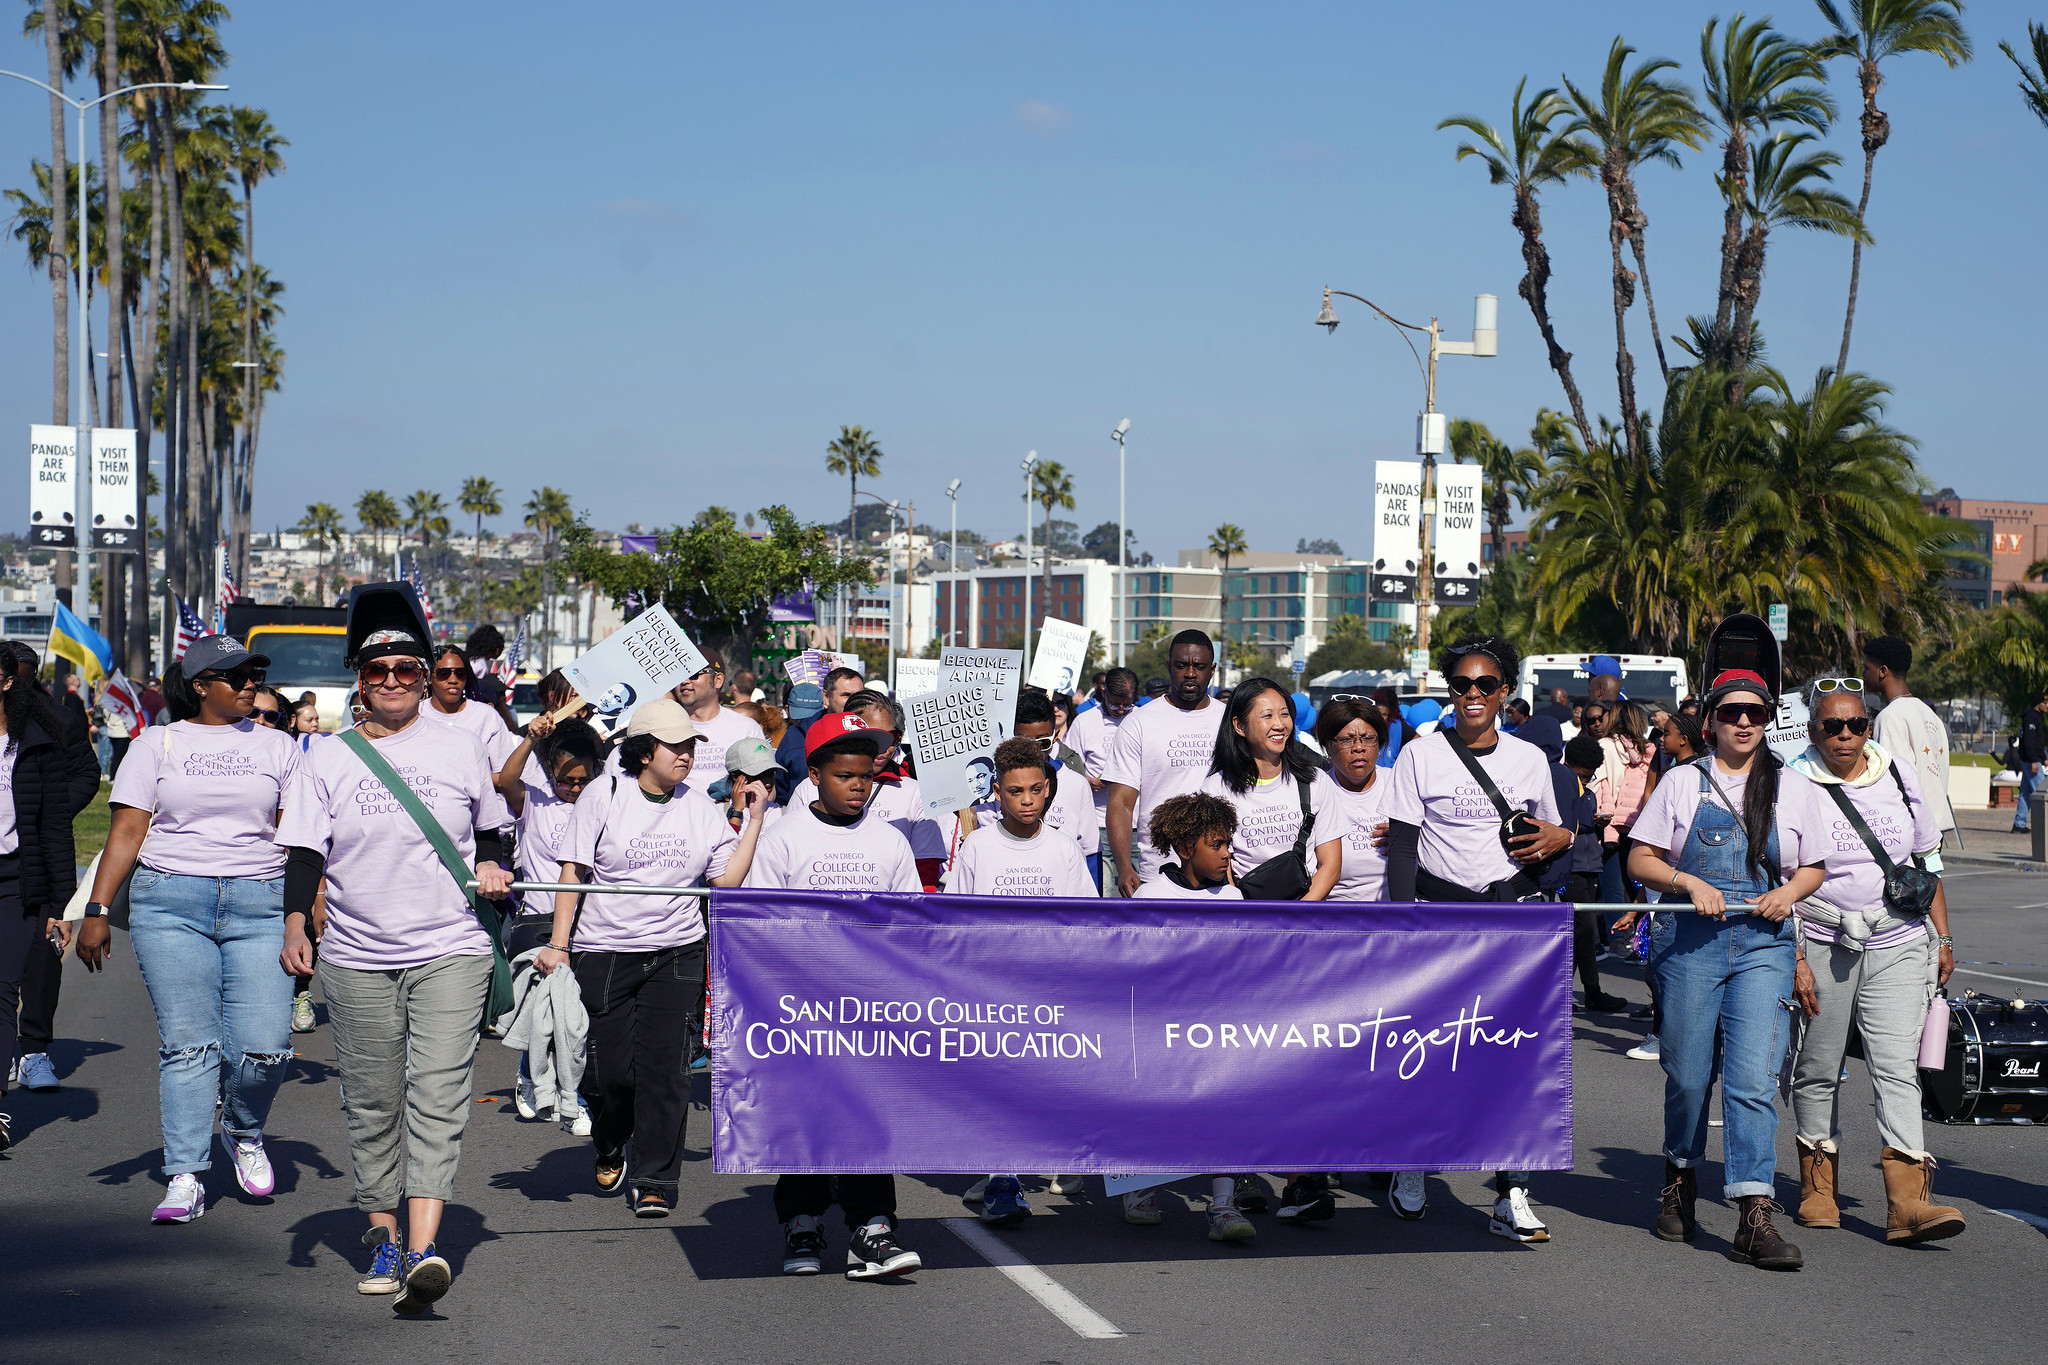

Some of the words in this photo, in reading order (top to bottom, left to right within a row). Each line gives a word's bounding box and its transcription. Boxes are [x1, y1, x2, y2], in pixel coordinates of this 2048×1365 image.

[31, 443, 75, 456] PANDAS
[100, 447, 127, 459] VISIT
[43, 458, 63, 469] ARE
[98, 461, 129, 472] THEM
[39, 471, 67, 483] BACK
[100, 475, 128, 486] NOW
[1375, 482, 1420, 496] PANDAS
[1446, 486, 1473, 499] VISIT
[1387, 498, 1408, 511] ARE
[1444, 501, 1475, 514] THEM
[1383, 513, 1411, 527] BACK
[1444, 517, 1473, 529] NOW
[645, 611, 693, 673] BECOME...
[635, 628, 648, 642] A
[645, 637, 679, 674] ROLE
[1042, 646, 1079, 664] SCHOOL
[623, 635, 664, 684] MODEL
[945, 654, 1018, 670] BECOME...
[898, 664, 939, 676] BECOM
[950, 669, 962, 683] A
[919, 678, 927, 688] A
[912, 685, 985, 717] BELONG
[915, 700, 987, 733] BELONG
[918, 716, 990, 748] BELONG
[1766, 729, 1809, 744] NFIDEN
[920, 732, 993, 764] BELONG
[1169, 739, 1208, 749] COLLEGE
[237, 756, 252, 764] OF
[1170, 758, 1212, 768] EDUCATIO
[186, 768, 255, 776] EDUCATION
[415, 775, 432, 786] OF
[1502, 786, 1515, 794] OF
[361, 800, 435, 816] EDUCAN
[878, 809, 891, 818] OF
[1052, 805, 1063, 814] OF
[1265, 804, 1288, 813] DIEGO
[1454, 807, 1499, 818] EDUCAT
[1241, 813, 1286, 827] COLLEGE
[1287, 811, 1301, 821] OF
[1880, 816, 1893, 826] OF
[629, 838, 672, 849] COLLEGE
[674, 838, 687, 847] OF
[1246, 833, 1297, 849] EDUCATIO
[624, 848, 691, 860] CONTINUING
[824, 852, 839, 860] SAN
[839, 852, 864, 860] DIEGO
[628, 859, 686, 870] EDUCATION
[812, 861, 860, 873] COLLEGE
[862, 862, 876, 872] OF
[1020, 866, 1043, 874] DIEGO
[808, 874, 879, 886] CONTINUING
[994, 875, 1039, 887] COLLEGE
[1039, 876, 1052, 885] OF
[991, 887, 1055, 897] CONTINUING
[779, 995, 833, 1024] SAN
[839, 996, 922, 1025] DIEGO
[926, 997, 1029, 1026] COLLEGE
[1034, 1004, 1065, 1026] OF
[745, 1022, 931, 1060] CONTINUING
[939, 1027, 1103, 1062] EDUCATION
[2000, 1058, 2041, 1078] Pearl
